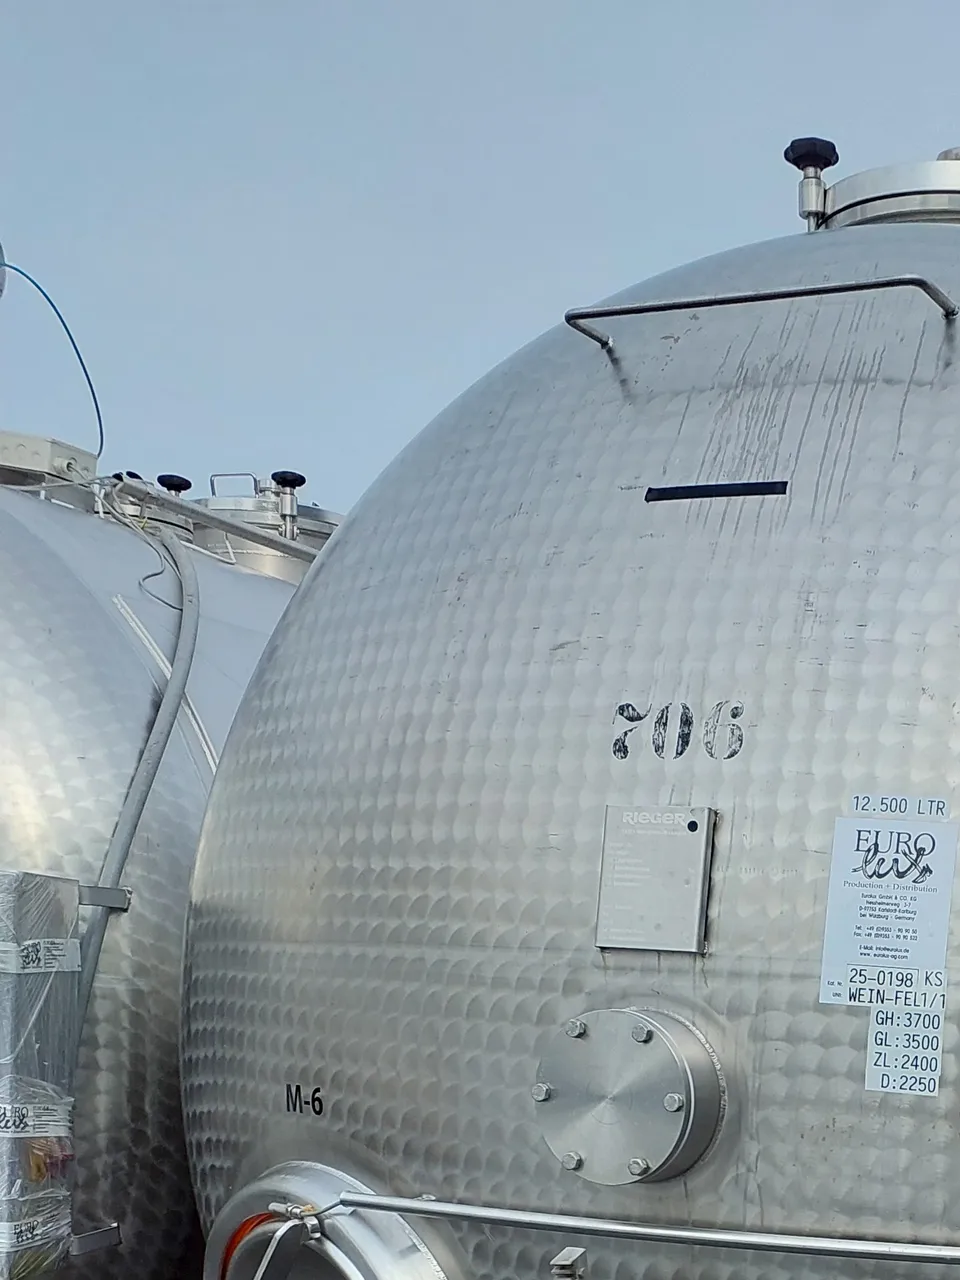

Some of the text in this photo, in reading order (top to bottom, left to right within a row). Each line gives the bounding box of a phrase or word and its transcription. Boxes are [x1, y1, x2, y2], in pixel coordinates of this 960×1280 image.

[611, 700, 745, 760] 706
[853, 795, 946, 816] 12.500 LTR
[853, 828, 936, 856] EURO
[843, 880, 884, 890] Production
[892, 883, 938, 893] Distribution
[849, 968, 914, 988] 25-0198
[924, 970, 943, 987] KS
[875, 1009, 940, 1030] GH:3700
[874, 1030, 939, 1051] GL:3500
[873, 1051, 938, 1073] ZL:2400
[880, 1073, 937, 1093] D:2250
[286, 1083, 324, 1116] M-6
